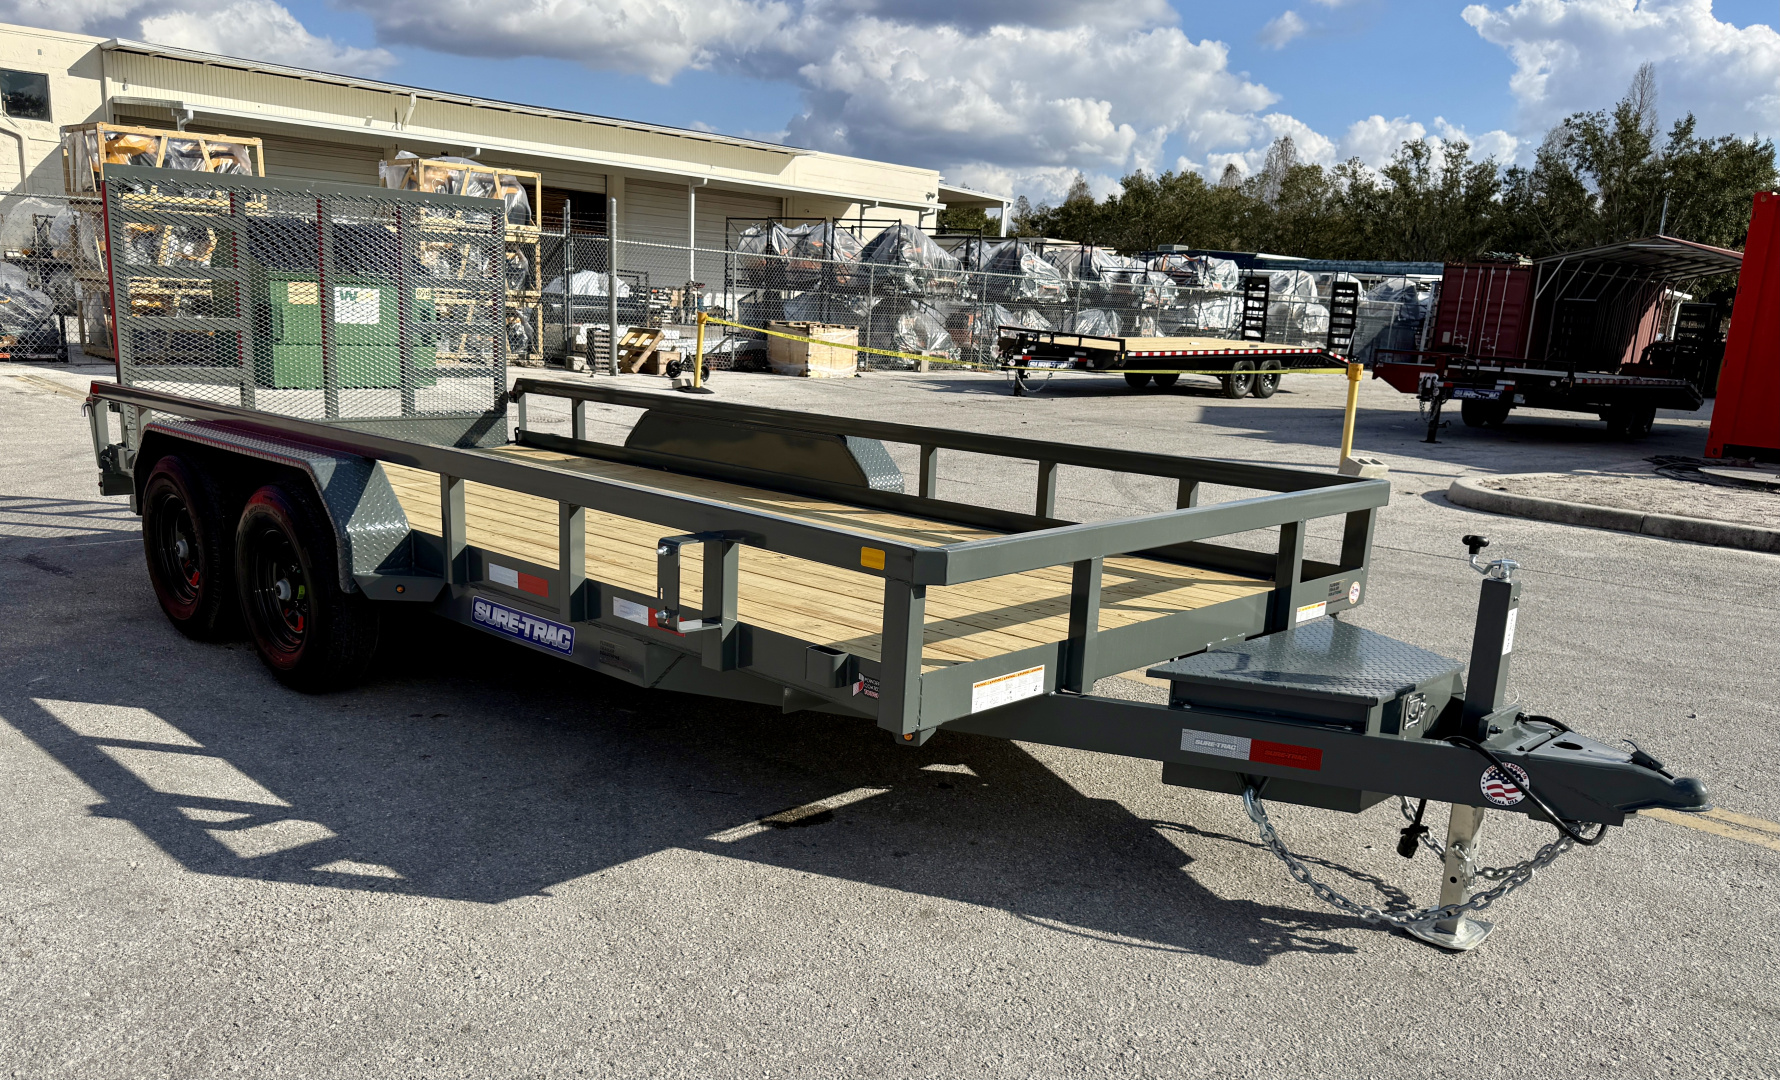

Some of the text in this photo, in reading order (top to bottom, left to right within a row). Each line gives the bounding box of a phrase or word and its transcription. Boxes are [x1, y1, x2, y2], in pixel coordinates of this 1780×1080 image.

[473, 601, 572, 650] SURE-TRAC
[1194, 739, 1237, 751] SURE-TRAC
[1264, 750, 1307, 761] SURE-TRAC
[1510, 763, 1524, 774] MADE
